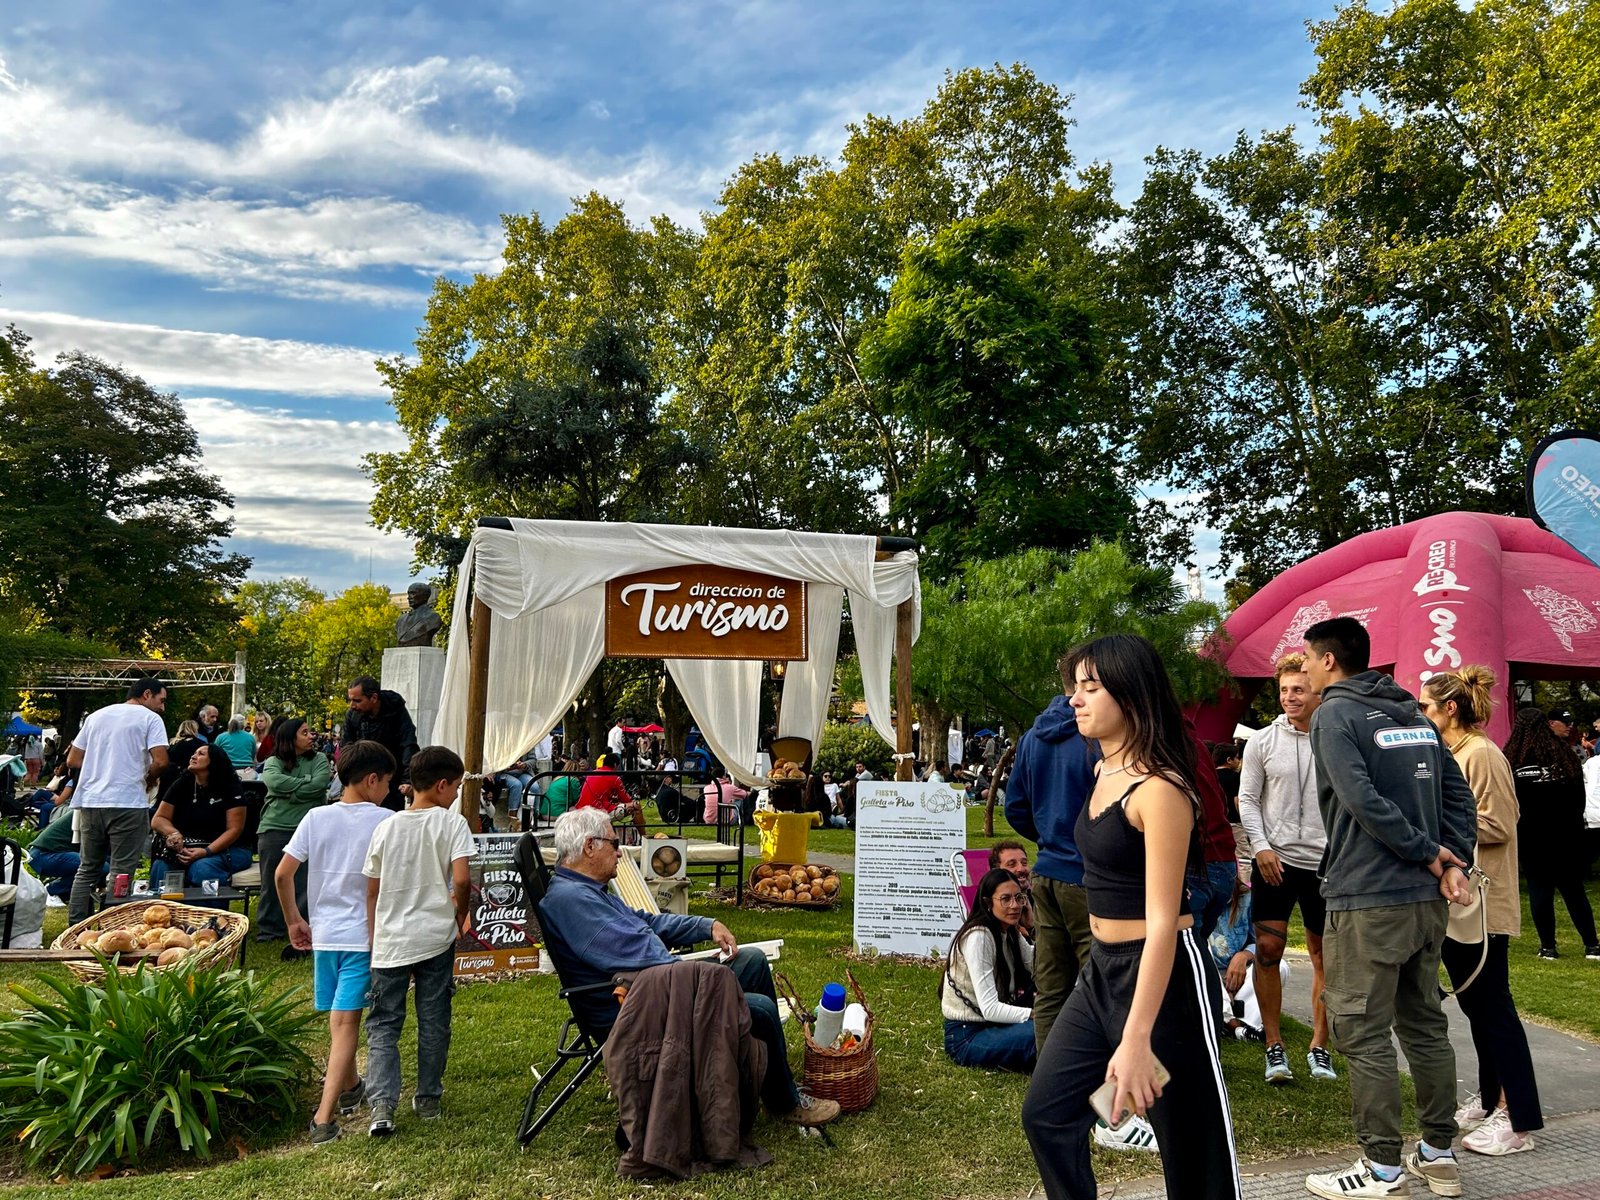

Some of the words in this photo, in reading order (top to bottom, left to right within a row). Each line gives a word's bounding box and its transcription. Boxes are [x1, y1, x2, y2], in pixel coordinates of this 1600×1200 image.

[1426, 540, 1446, 588] RECREO
[689, 582, 763, 598] dirección
[767, 585, 786, 599] de
[620, 581, 790, 637] Turismo
[860, 797, 887, 809] Galleta
[896, 797, 914, 807] Piso
[483, 870, 522, 883] FIESTA
[476, 905, 527, 931] Galleta
[491, 925, 525, 944] Piso
[455, 956, 495, 970] Turismo
